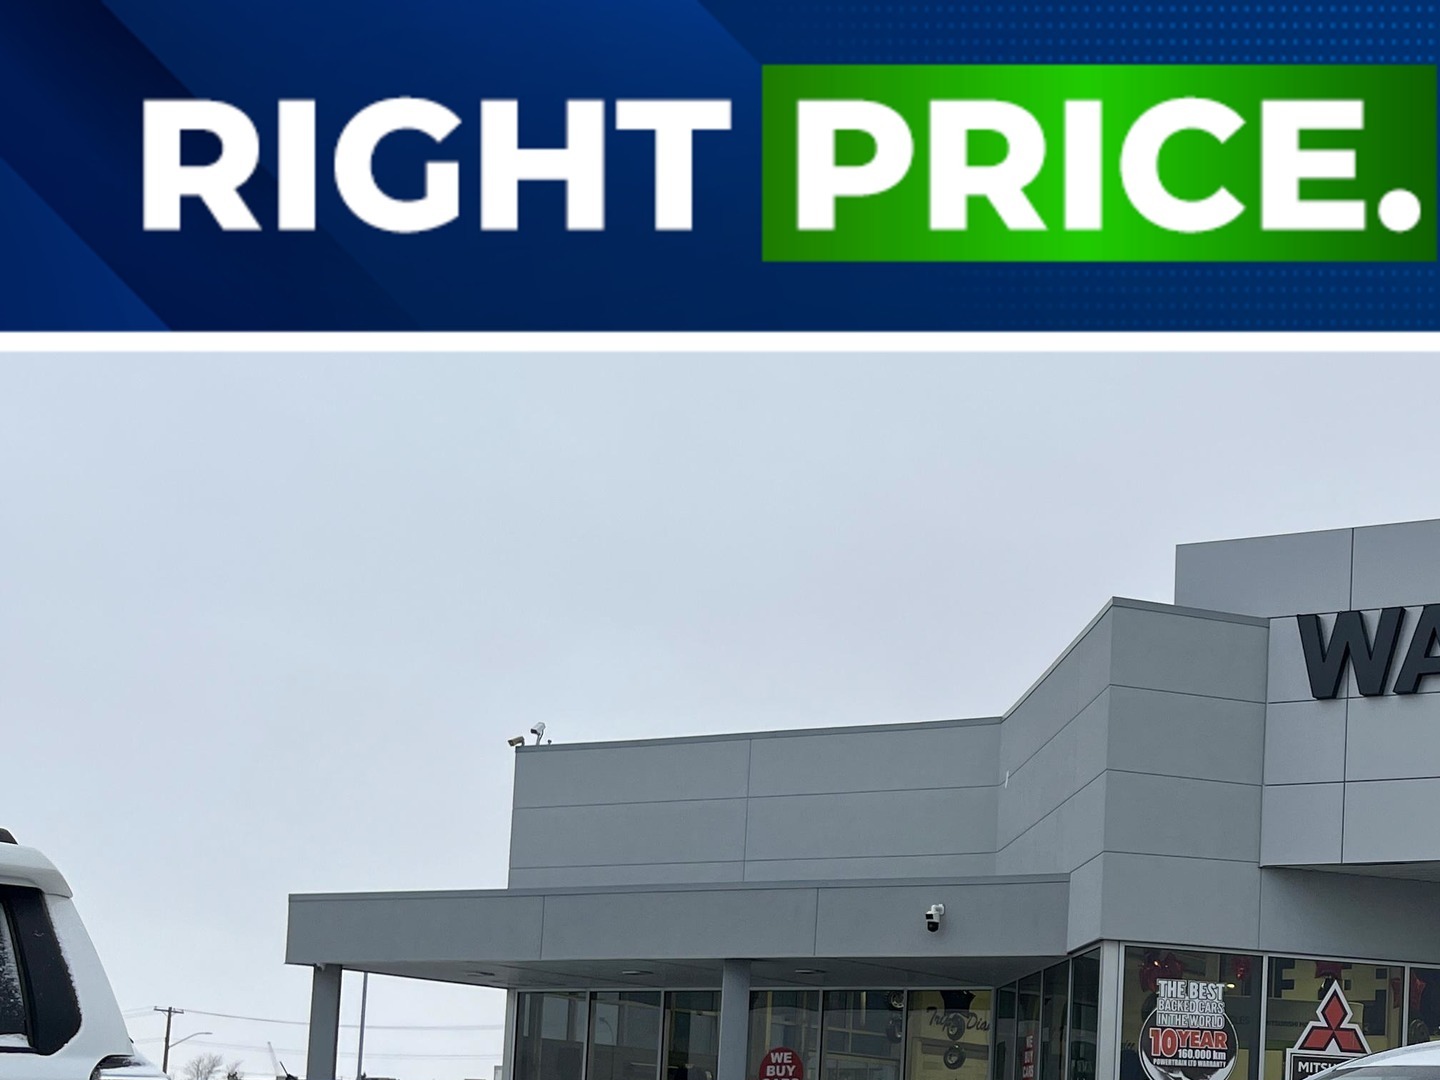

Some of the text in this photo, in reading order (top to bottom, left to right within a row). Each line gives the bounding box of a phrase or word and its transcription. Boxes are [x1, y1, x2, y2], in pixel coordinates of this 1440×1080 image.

[1158, 980, 1225, 1000] THE BEST
[1158, 999, 1225, 1014] BACKED CARS
[1158, 1013, 1223, 1028] IN THE WORLD
[1149, 1028, 1228, 1057] 10 YEAR
[770, 1052, 793, 1064] WE
[1213, 1050, 1226, 1060] km
[1198, 1060, 1227, 1068] WARRANTY
[766, 1065, 796, 1077] BUY
